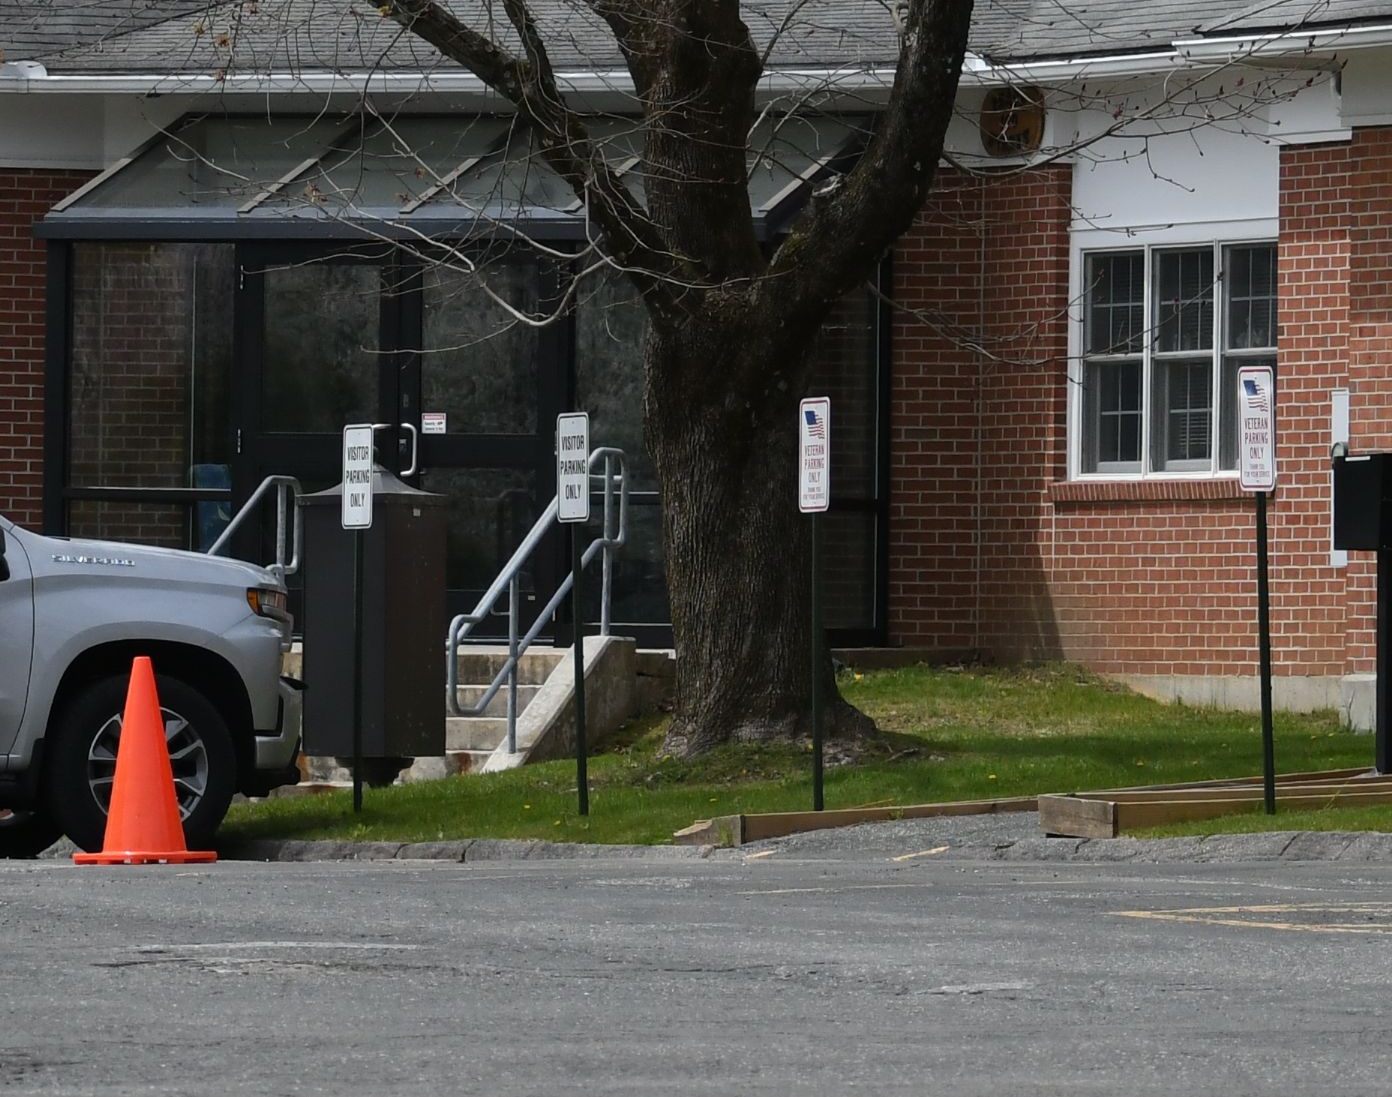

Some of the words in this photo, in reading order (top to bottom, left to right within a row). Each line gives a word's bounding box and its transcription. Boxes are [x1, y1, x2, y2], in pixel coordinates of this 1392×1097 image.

[1244, 417, 1268, 430] VETERAN
[561, 435, 584, 451] VISITOR
[1244, 432, 1268, 445] PARKING
[348, 446, 369, 461] VISITOR
[804, 444, 824, 457] VETERAN
[1250, 446, 1264, 459] ONLY
[560, 459, 585, 475] PARKING
[804, 458, 824, 470] PARKING
[346, 469, 369, 484] PARKING
[808, 471, 820, 483] ONLY
[565, 484, 581, 500] ONLY
[350, 493, 365, 507] ONLY
[52, 554, 136, 567] SILVERADO
